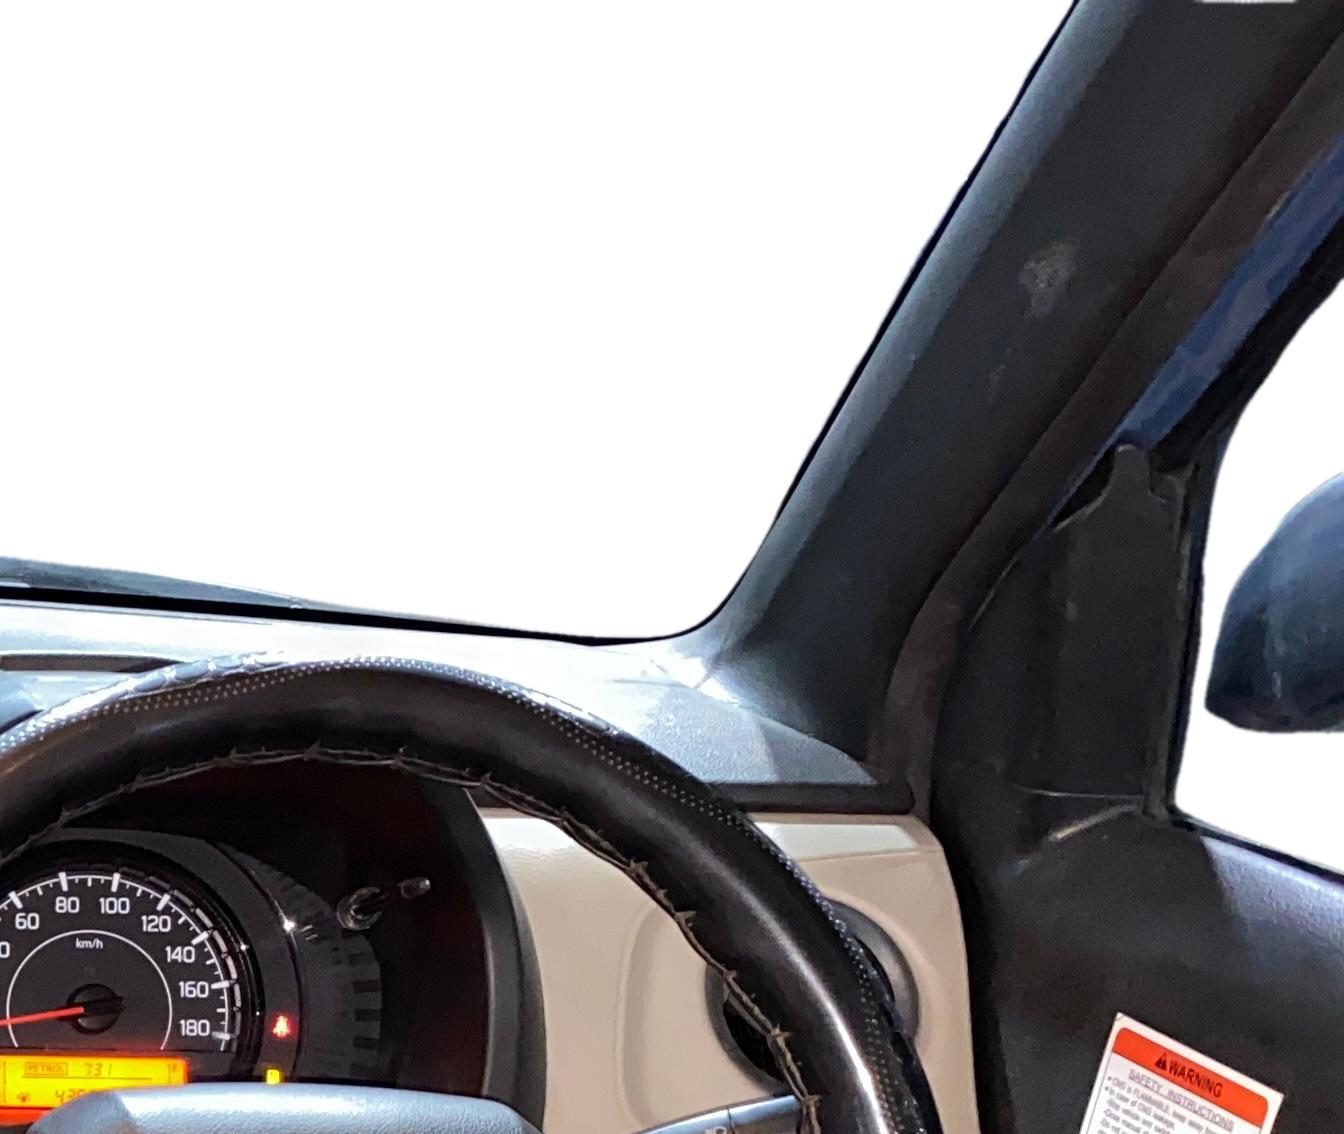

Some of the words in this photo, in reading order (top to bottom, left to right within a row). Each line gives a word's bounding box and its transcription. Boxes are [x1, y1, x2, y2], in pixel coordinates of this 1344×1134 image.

[55, 896, 80, 914] 80
[99, 897, 130, 914] 100
[15, 913, 40, 930] 60
[141, 915, 171, 933] 120
[75, 938, 103, 950] km/h
[165, 945, 196, 963] 140
[178, 981, 209, 998] 160
[179, 1019, 210, 1037] 180
[1167, 1058, 1224, 1099] WARNING
[1127, 1068, 1162, 1095] SAFETY
[1166, 1088, 1234, 1133] INSTRUCTIONS
